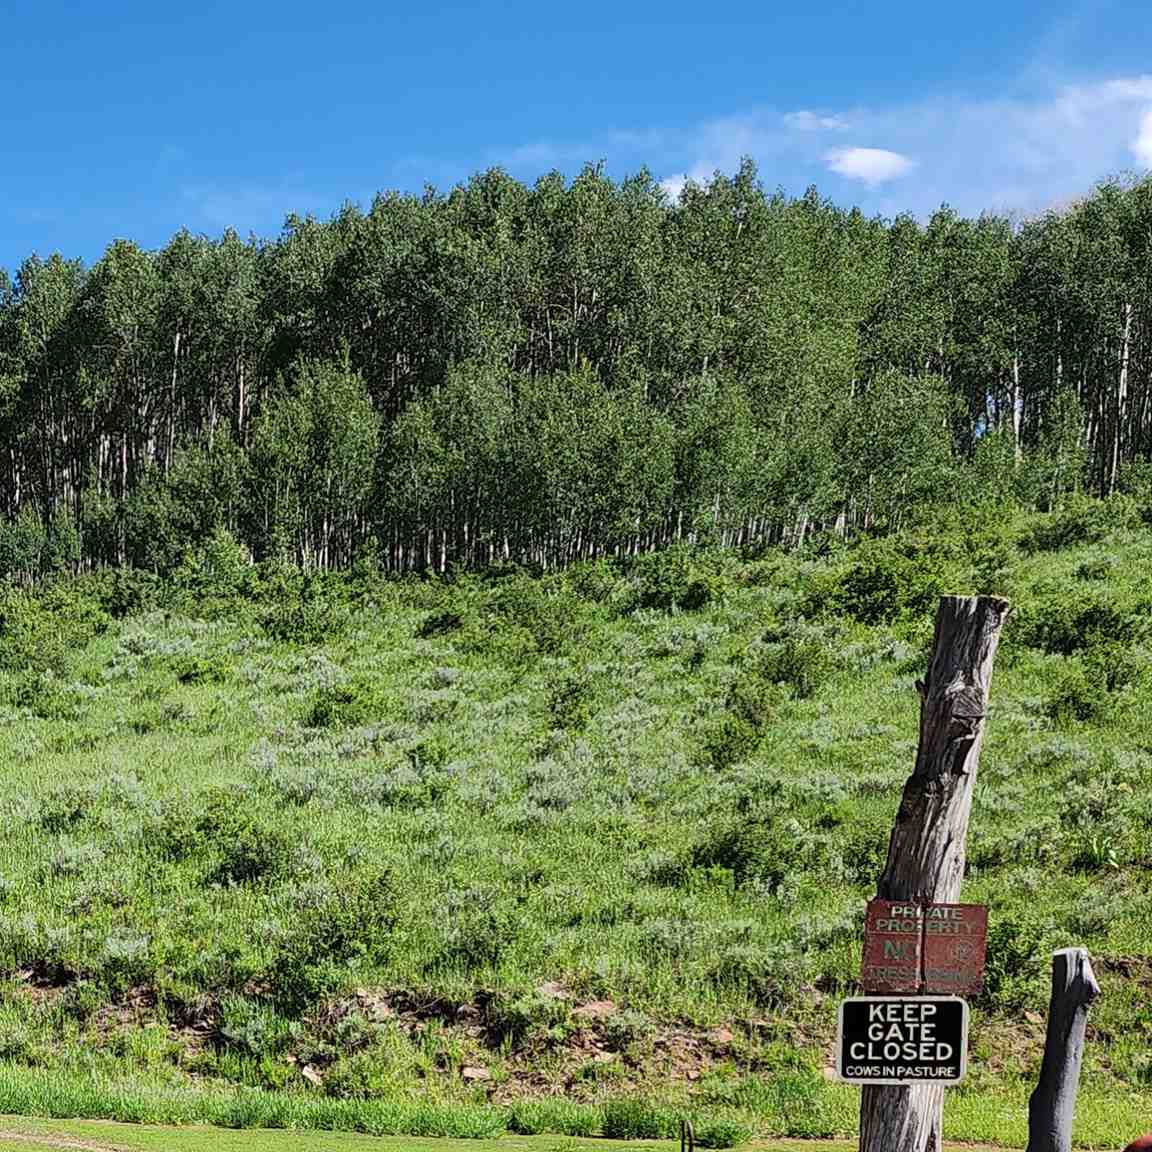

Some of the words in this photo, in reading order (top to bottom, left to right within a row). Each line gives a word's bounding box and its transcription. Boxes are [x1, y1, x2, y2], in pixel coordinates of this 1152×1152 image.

[869, 1004, 937, 1022] KEEP
[868, 1023, 936, 1041] GATE
[850, 1042, 953, 1060] CLOSED
[846, 1066, 881, 1076] COWS
[882, 1066, 895, 1076] IN
[897, 1066, 956, 1077] PASTURE
